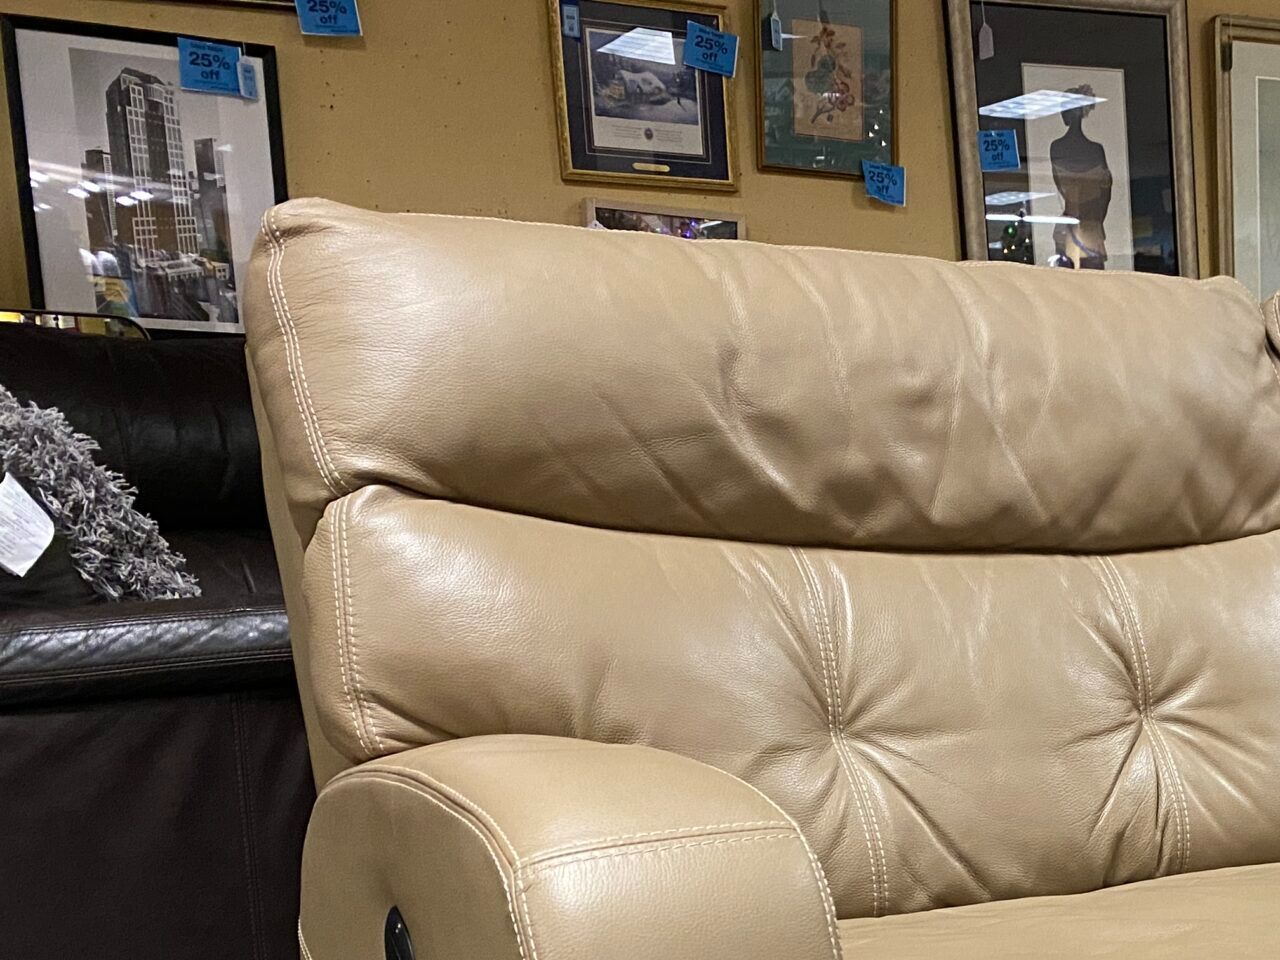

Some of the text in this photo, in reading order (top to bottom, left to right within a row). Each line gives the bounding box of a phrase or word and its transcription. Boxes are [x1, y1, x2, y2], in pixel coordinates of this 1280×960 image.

[307, 0, 348, 14] 25%
[319, 14, 338, 24] off
[694, 34, 728, 54] 25%
[188, 51, 231, 70] 25%
[702, 52, 718, 62] off
[200, 69, 220, 80] off
[983, 139, 1010, 151] 25%
[991, 152, 1004, 161] off
[868, 170, 898, 186] 25%
[876, 185, 890, 194] off
